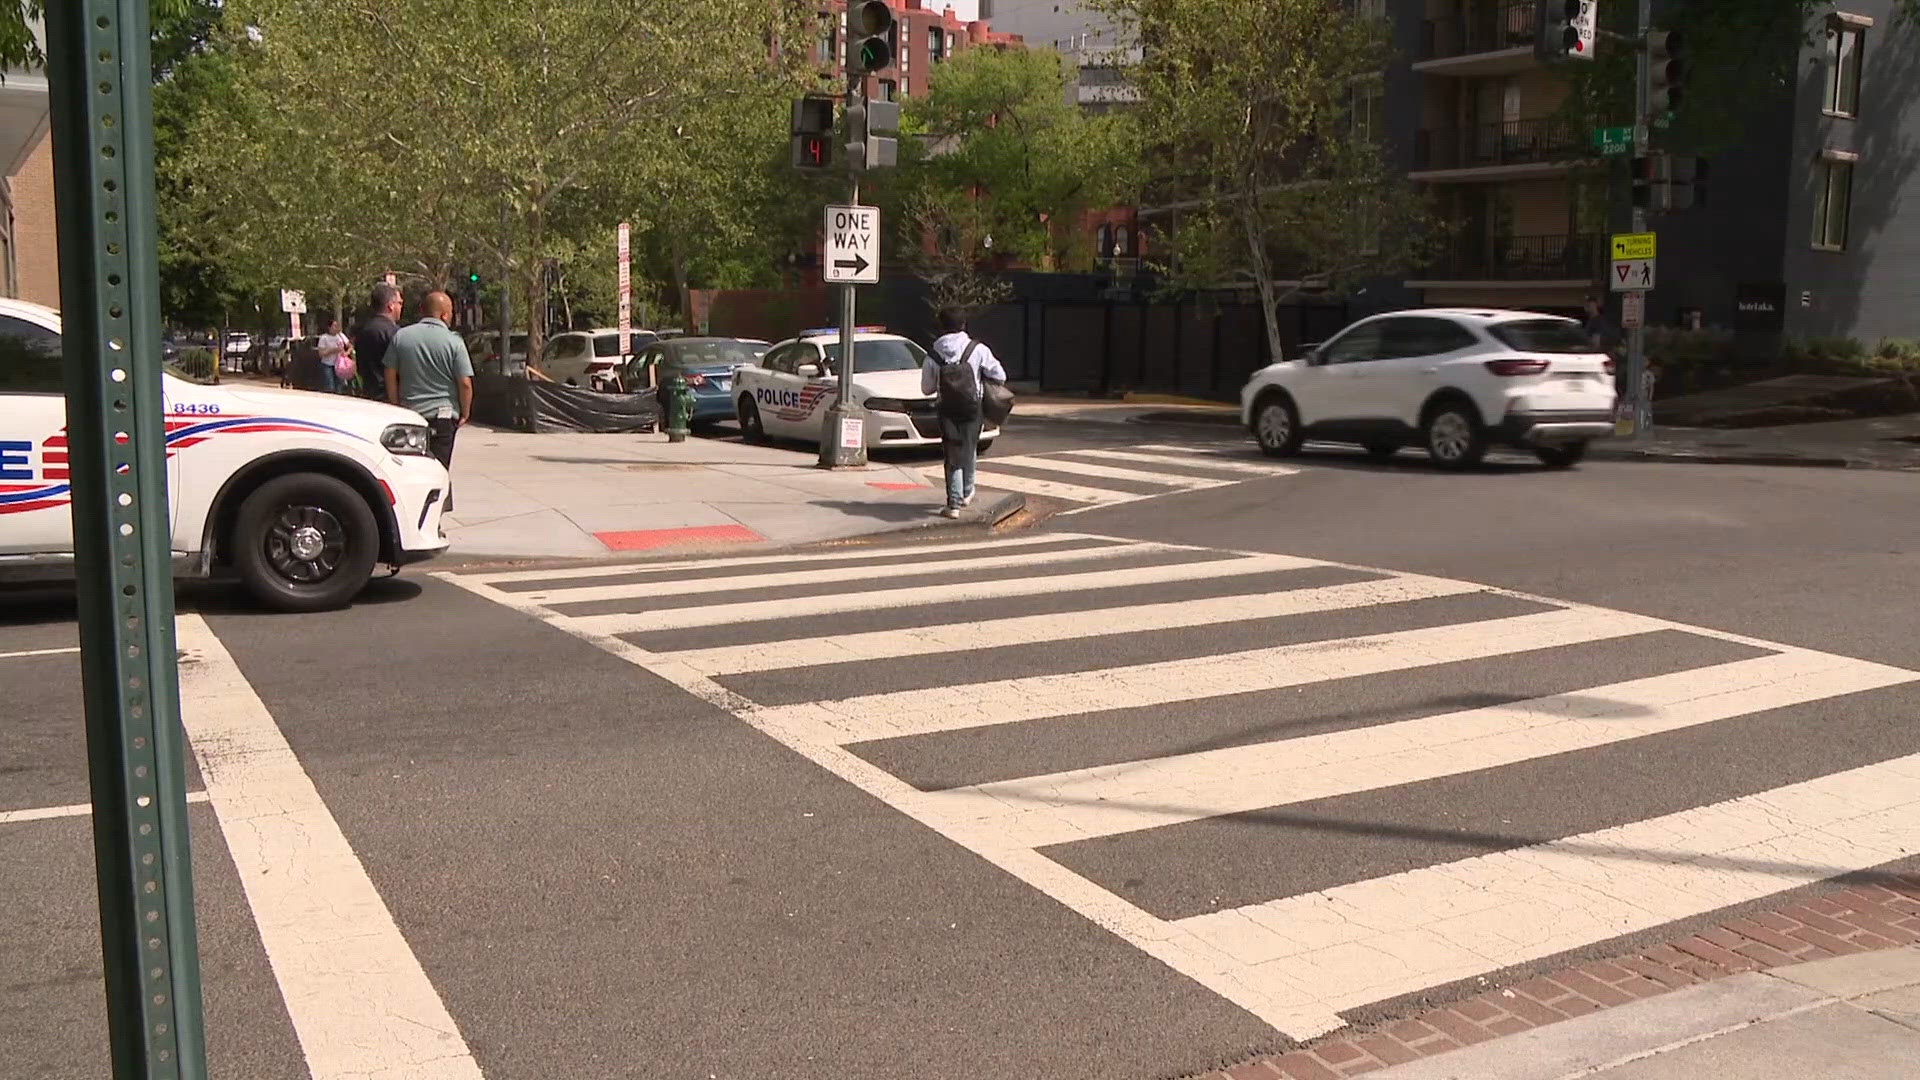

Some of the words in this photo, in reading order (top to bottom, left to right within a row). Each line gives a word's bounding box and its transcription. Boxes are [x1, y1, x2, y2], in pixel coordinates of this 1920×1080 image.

[1603, 129, 1612, 143] L
[810, 139, 820, 164] 4
[1603, 143, 1626, 154] 2200
[835, 212, 870, 230] ONE
[834, 232, 870, 250] WAY
[1626, 248, 1652, 256] VEHICLES
[757, 387, 799, 408] POLICE
[174, 403, 220, 414] 8436
